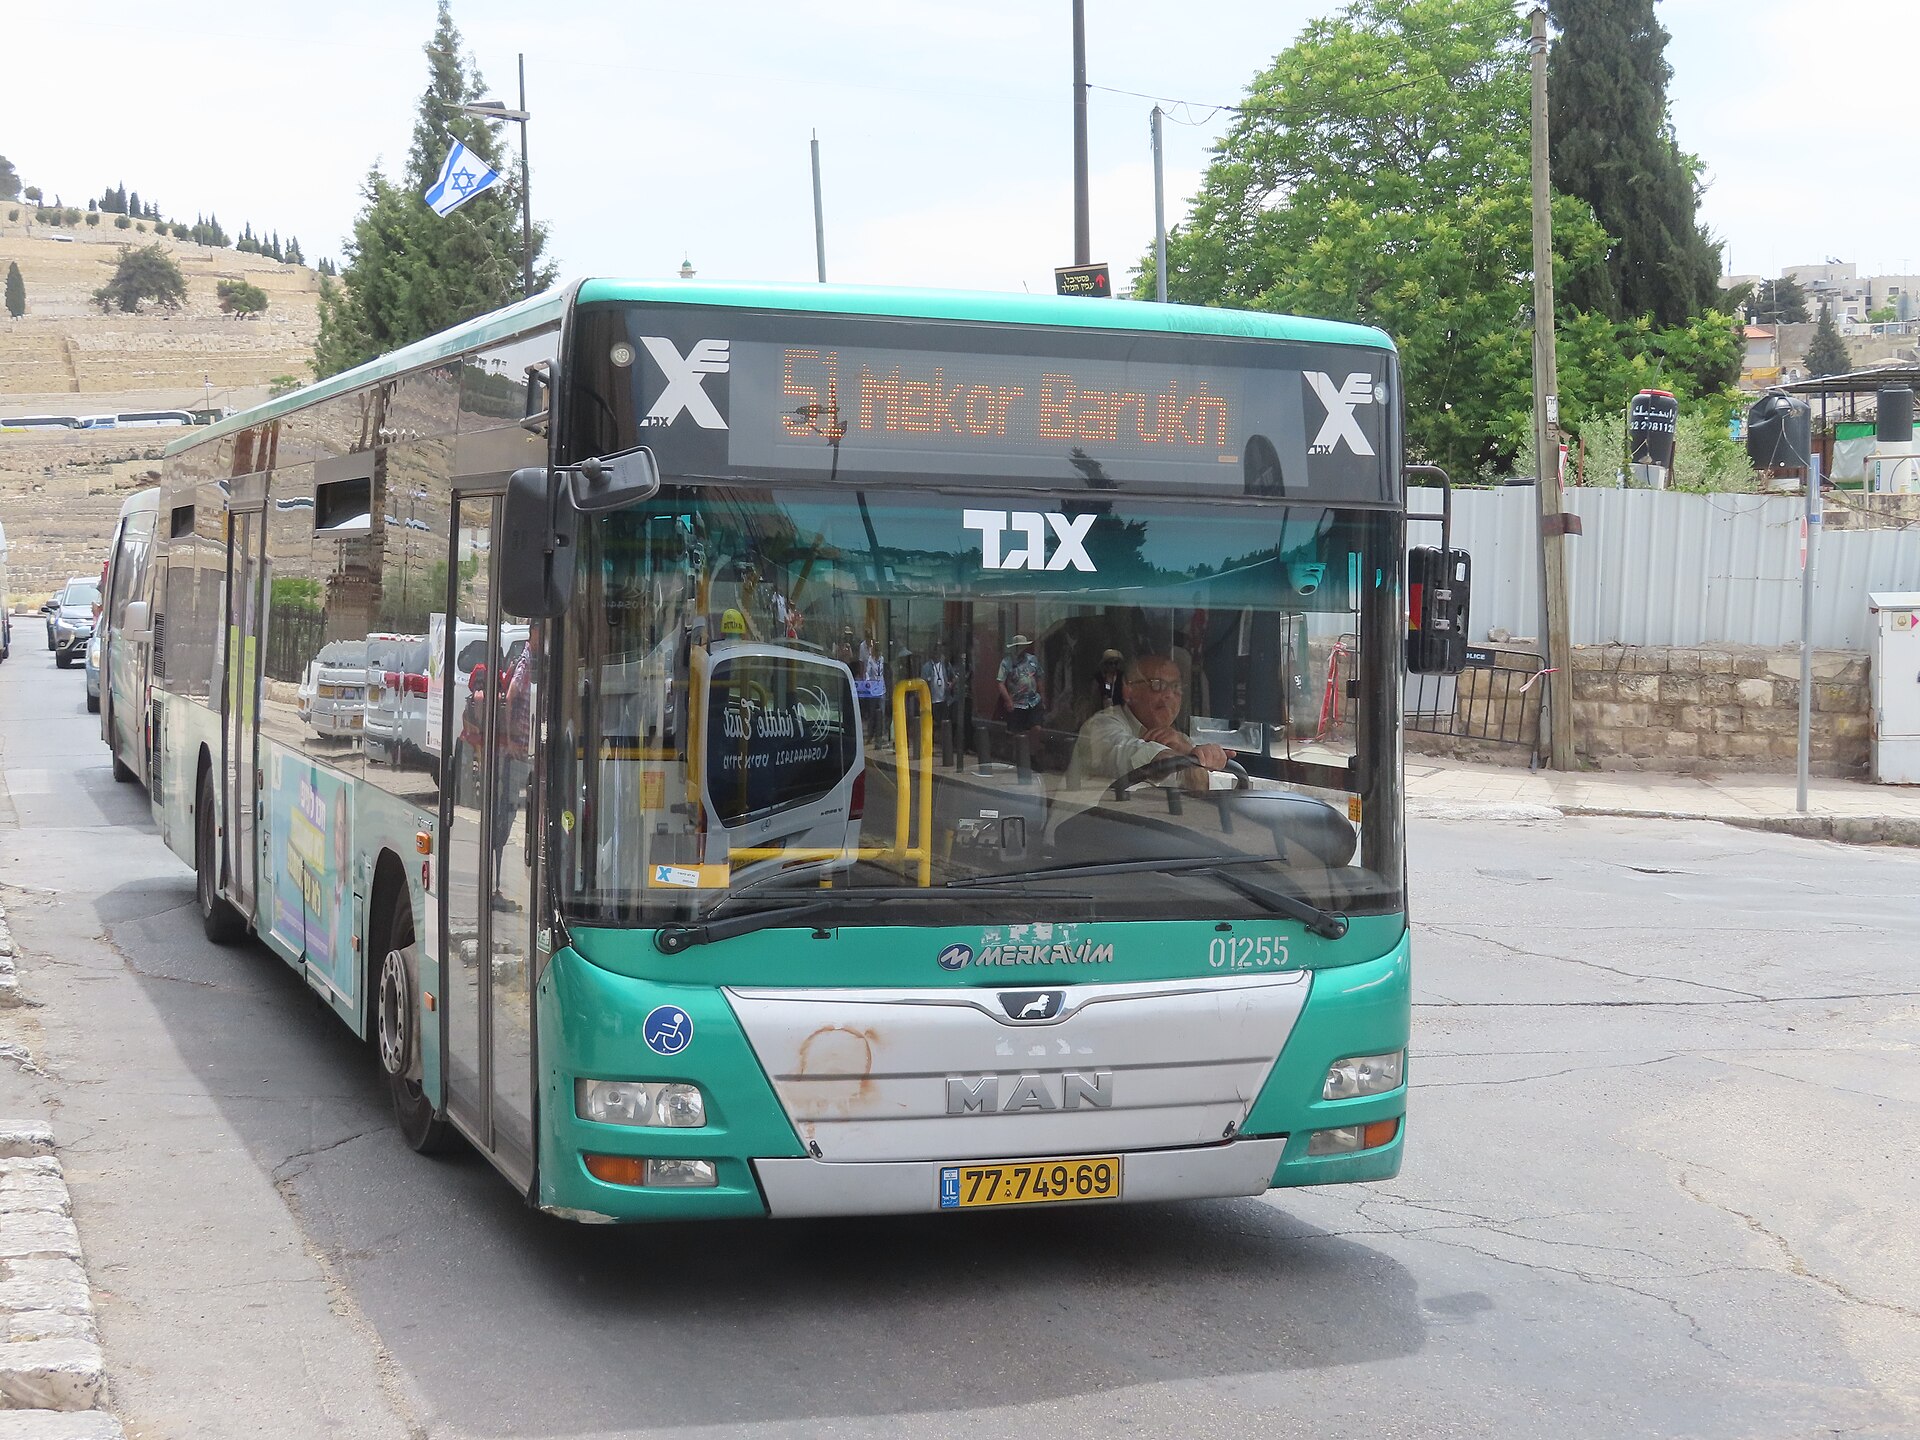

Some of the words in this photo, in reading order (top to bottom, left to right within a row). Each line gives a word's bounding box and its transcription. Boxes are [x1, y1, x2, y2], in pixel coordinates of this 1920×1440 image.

[782, 349, 844, 437] 51
[860, 363, 1025, 435] Mekor
[1039, 373, 1227, 445] Barukh
[963, 508, 1098, 572] אגד
[1209, 936, 1289, 967] 01255
[945, 1071, 1113, 1114] MAN
[946, 1180, 957, 1196] IL
